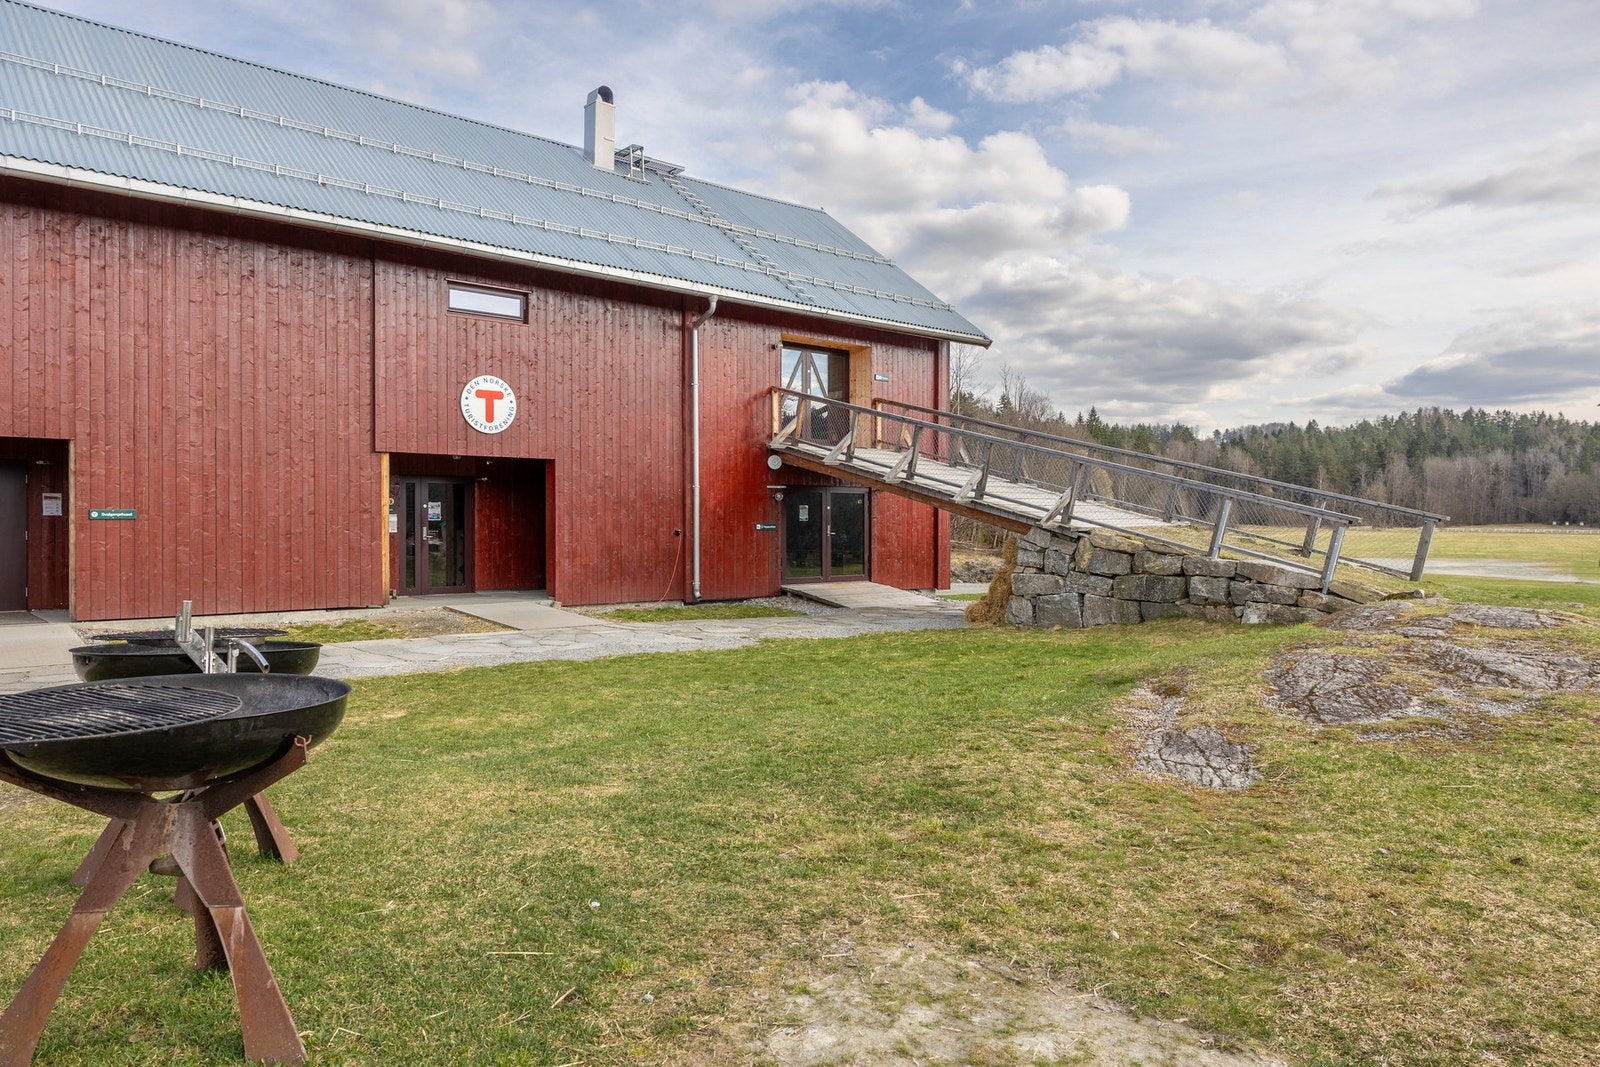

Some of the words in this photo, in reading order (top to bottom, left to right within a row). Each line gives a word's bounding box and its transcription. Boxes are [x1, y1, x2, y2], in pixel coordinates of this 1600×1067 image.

[466, 380, 480, 394] DEN
[483, 377, 512, 397] NORSKE
[464, 404, 515, 432] TURISTFORENING
[475, 389, 504, 423] T
